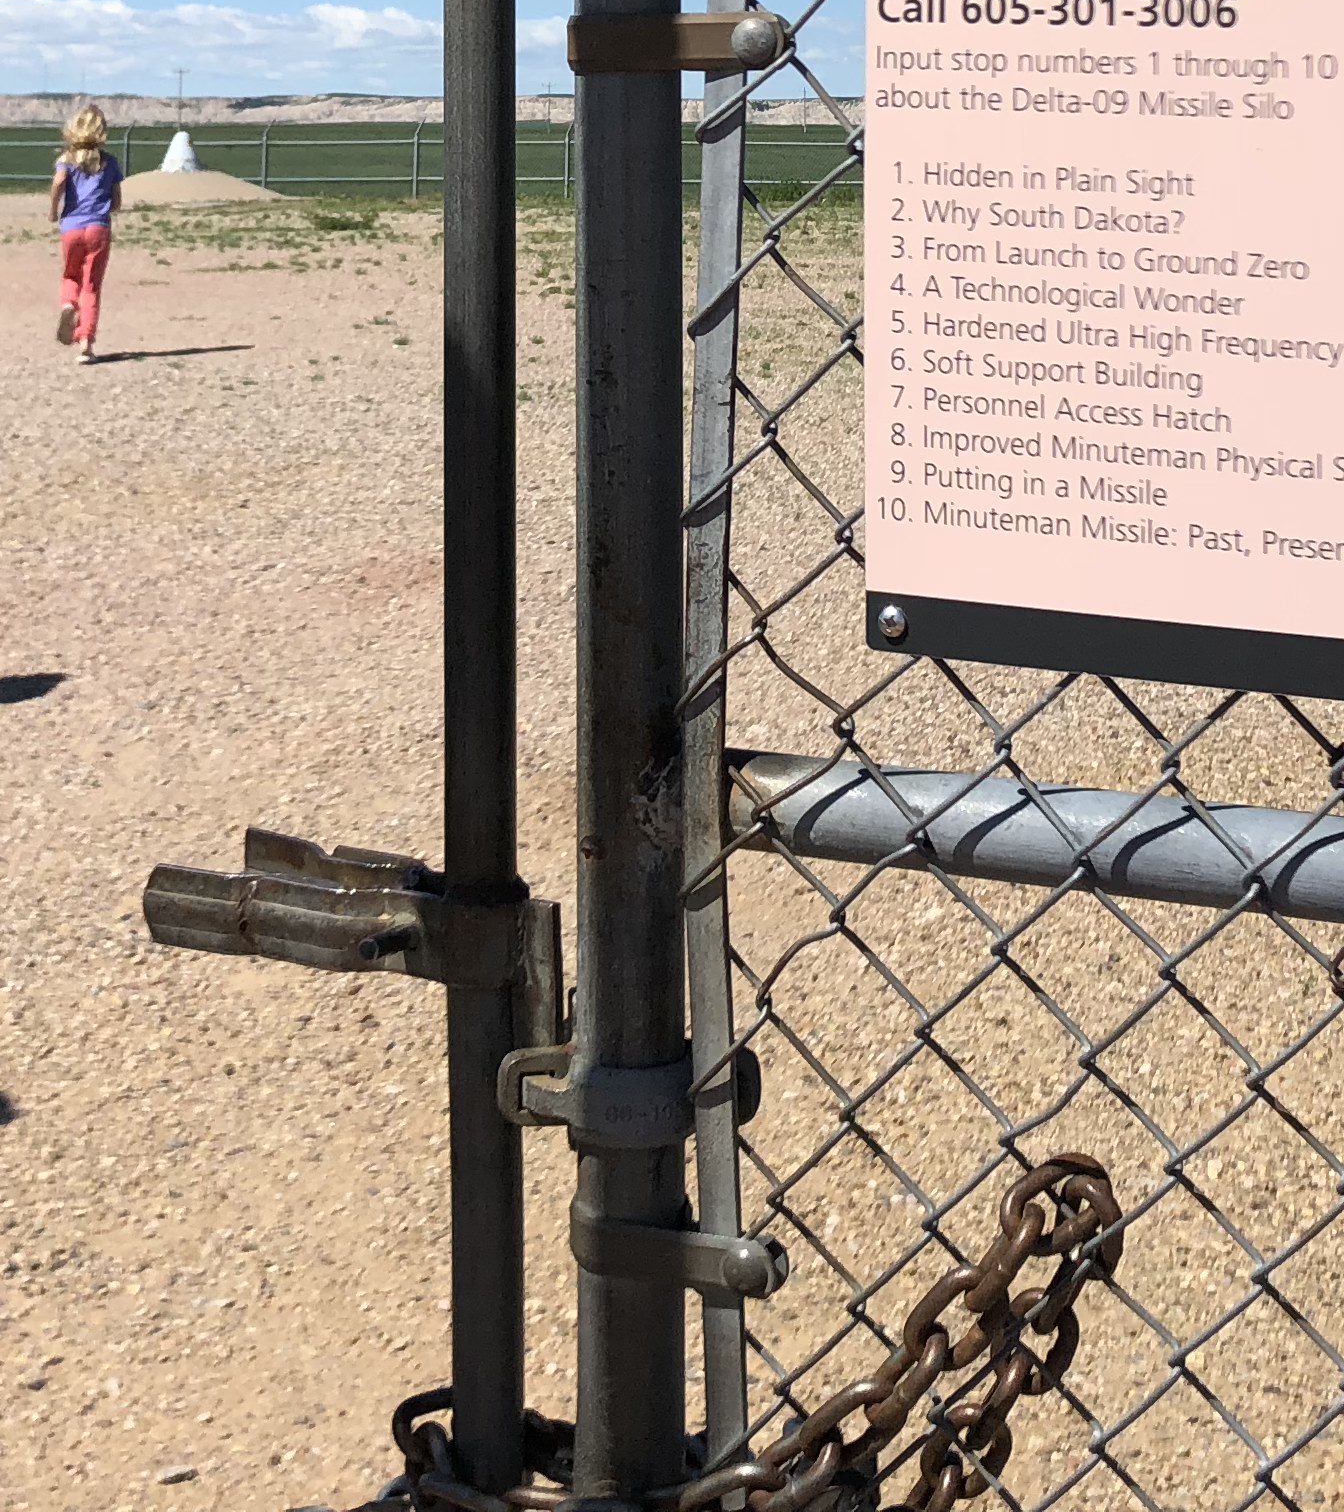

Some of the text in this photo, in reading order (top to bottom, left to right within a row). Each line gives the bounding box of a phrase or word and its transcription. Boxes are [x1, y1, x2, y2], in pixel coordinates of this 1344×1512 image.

[876, 44, 944, 77] Input
[950, 47, 1009, 79] stop
[1017, 47, 1138, 77] numbers
[1148, 50, 1160, 76] 1
[1172, 49, 1289, 87] through
[1301, 53, 1339, 81] 10
[875, 82, 1295, 121] about the Delta-09 Missile Silo
[893, 160, 1195, 203] 1. Hidden in Plain Sight
[890, 197, 1185, 236] 2. Why South Dakota?
[890, 234, 1310, 281] 3. From Launch to Ground Zero
[889, 272, 1246, 317] 4. A Technological Wonder
[891, 308, 913, 335] 5.
[923, 311, 1047, 344] Hardened
[1056, 318, 1120, 349] Ultra
[1129, 323, 1192, 359] High
[1201, 327, 1344, 370] Frequency
[890, 346, 1203, 400] 6. Soft Support Building
[890, 383, 1232, 434] 7. Personnel Access Hatch
[890, 421, 913, 448] 8.
[923, 423, 1042, 459] Improved
[1051, 433, 1206, 471] Minuteman
[1216, 446, 1323, 482] Physical
[890, 458, 1168, 508] 9. Putting in a Missile
[877, 495, 913, 523] 10.
[924, 499, 1071, 538] Minuteman
[1081, 513, 1178, 548] Missile:
[1188, 522, 1251, 558] Past,
